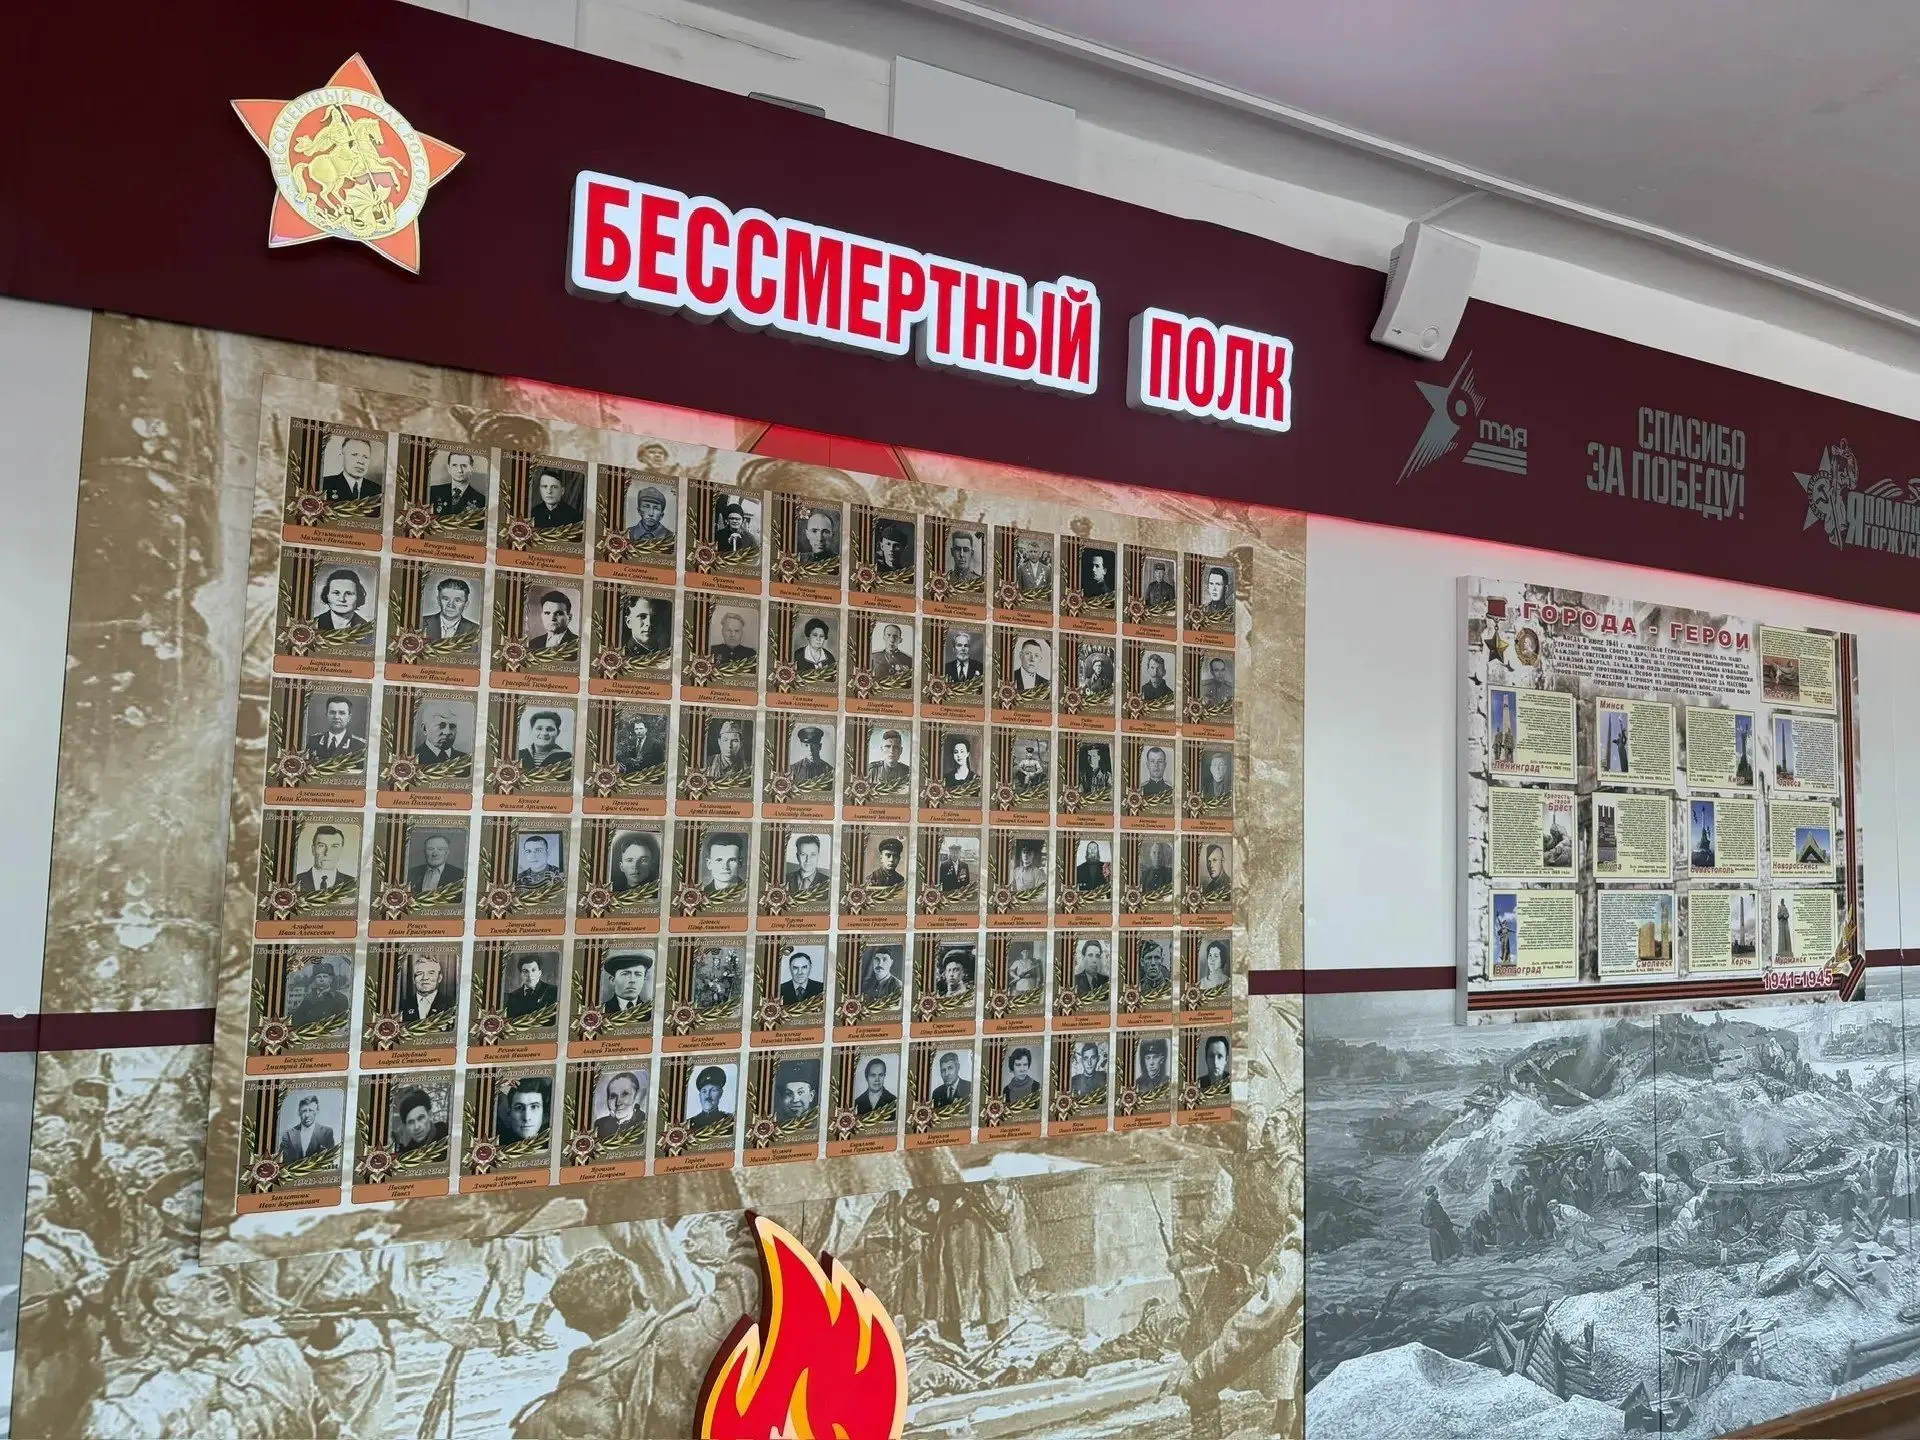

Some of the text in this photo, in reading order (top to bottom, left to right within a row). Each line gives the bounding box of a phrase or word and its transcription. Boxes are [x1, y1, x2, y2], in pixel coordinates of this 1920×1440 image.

[584, 181, 1285, 423] БЕССМЕРТНЫЙ ПОЛК
[1638, 406, 1746, 470] СПАСИБО
[1587, 442, 1625, 497] ЗА
[1632, 450, 1745, 521] ПОБЕДУ!
[1845, 491, 1865, 547] Я
[1523, 601, 1636, 636] ГОРОДА
[1670, 621, 1749, 650] ГЕРОИ
[1599, 700, 1624, 710] Минск
[1493, 759, 1540, 774] Ленинград
[1776, 777, 1800, 788] Одесса
[1636, 959, 1672, 969] Смоленск
[1731, 956, 1751, 966] Керчь
[1762, 968, 1833, 989] 1941-1945
